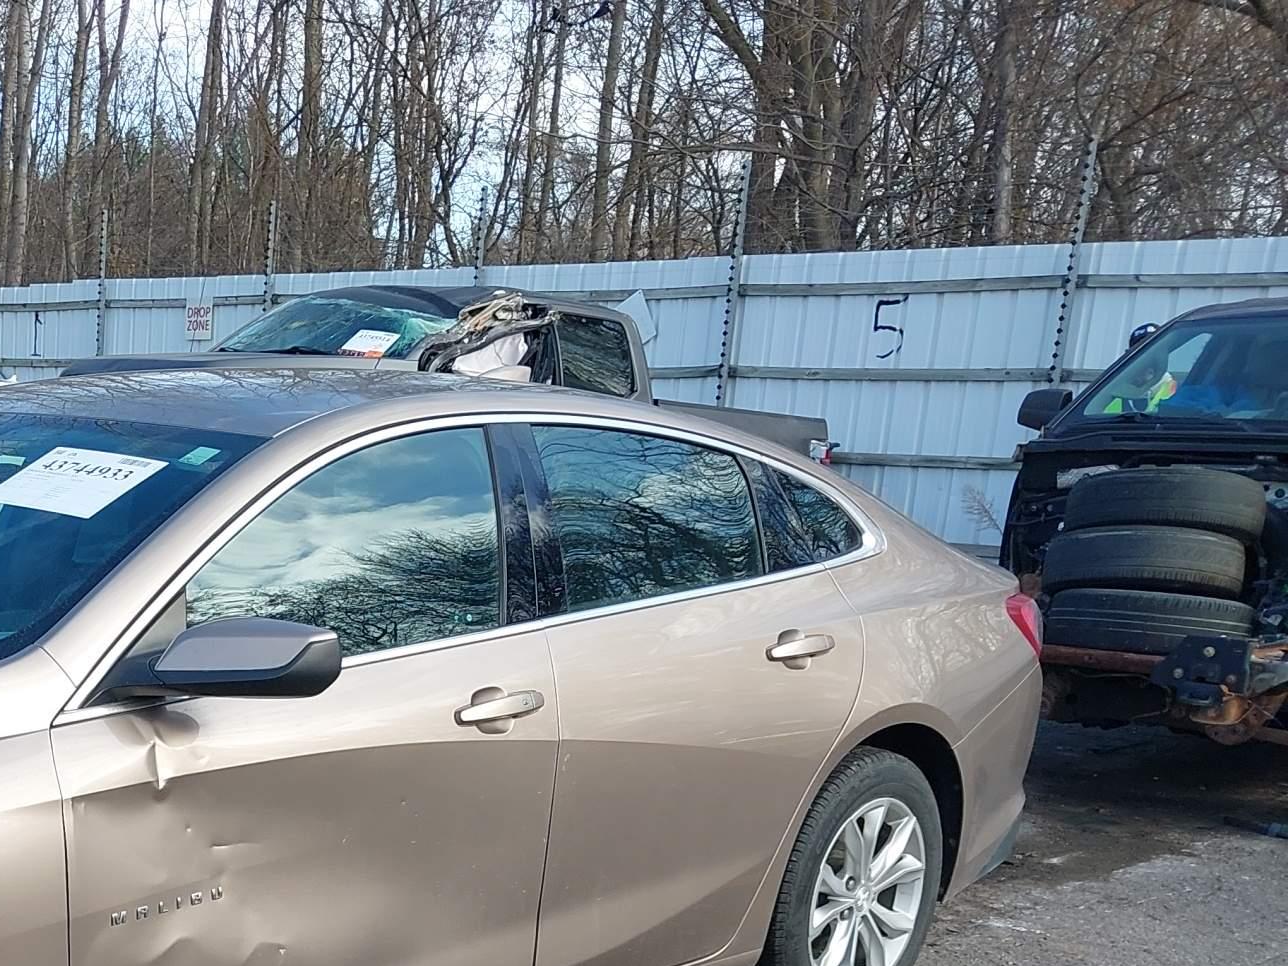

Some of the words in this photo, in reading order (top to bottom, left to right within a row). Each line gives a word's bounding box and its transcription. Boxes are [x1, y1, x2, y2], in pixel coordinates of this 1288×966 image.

[187, 306, 211, 319] DROP
[187, 319, 211, 331] ZONE
[874, 294, 909, 358] 5
[42, 459, 135, 481] 43744933
[110, 886, 224, 926] MALIBU
